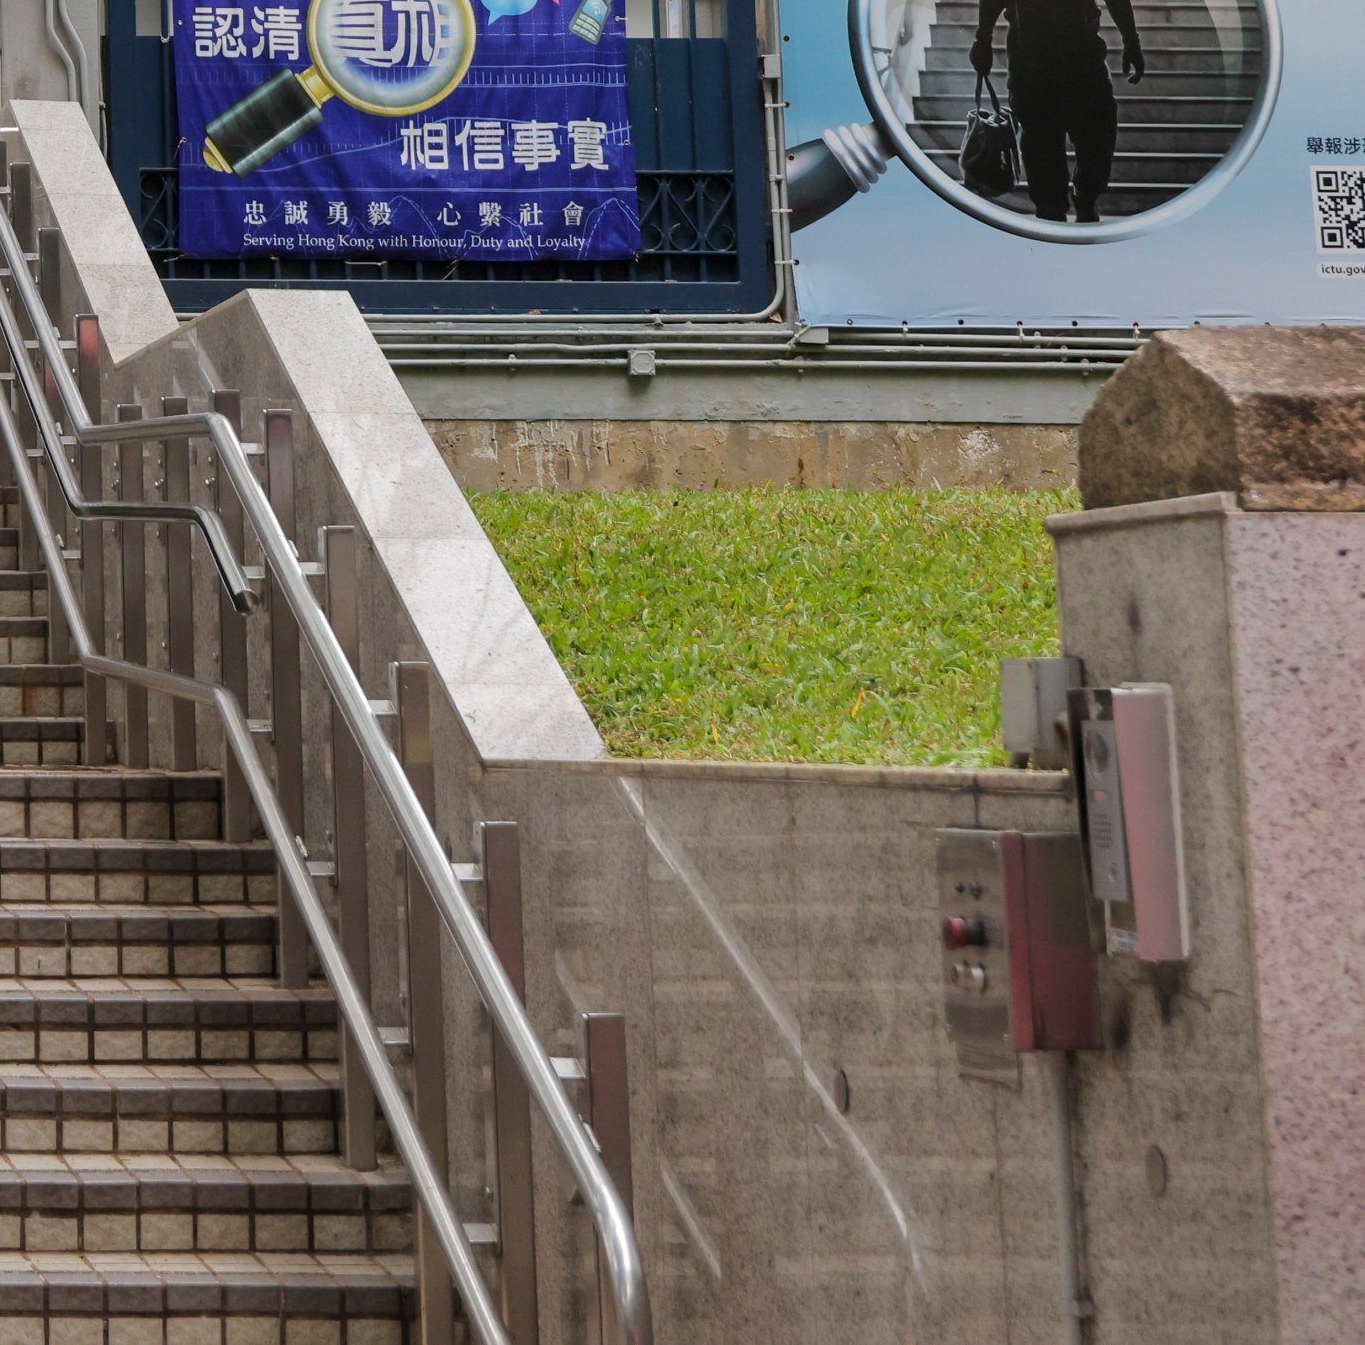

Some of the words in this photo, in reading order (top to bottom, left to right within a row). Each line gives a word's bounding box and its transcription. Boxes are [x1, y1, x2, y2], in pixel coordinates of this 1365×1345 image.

[192, 6, 303, 61] 認清
[400, 119, 609, 171] 相信事實
[1307, 137, 1365, 154] 舉報涉
[243, 201, 392, 226] 忠誠勇毅
[437, 201, 585, 227] 心繫社會
[243, 234, 294, 249] Serving
[298, 234, 335, 250] Hong
[339, 234, 374, 250] Kong
[378, 234, 408, 247] with
[411, 235, 467, 251] Honour,
[471, 235, 503, 251] Duty
[507, 235, 532, 248] and
[537, 235, 586, 251] Loyalty
